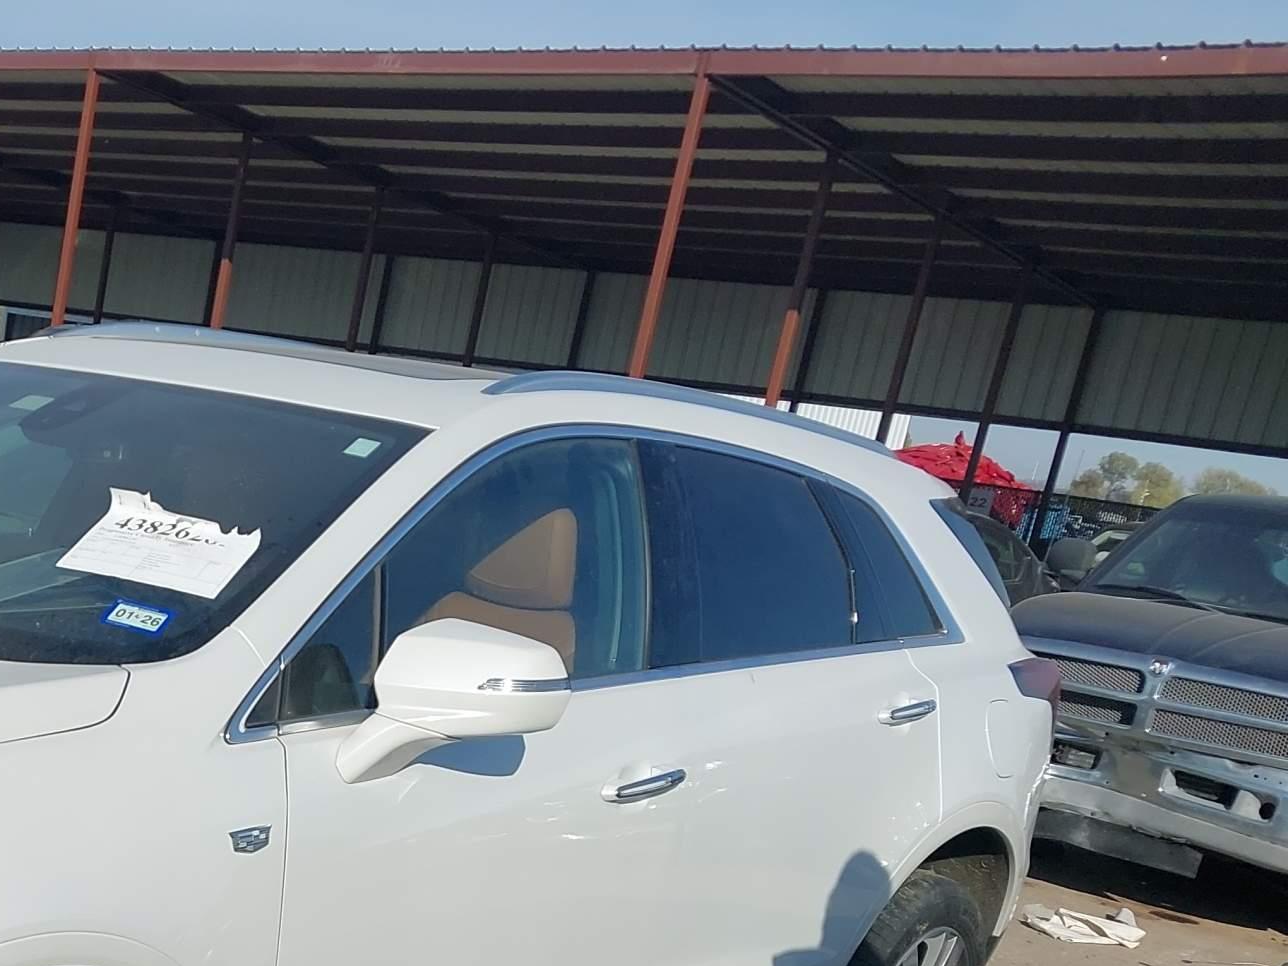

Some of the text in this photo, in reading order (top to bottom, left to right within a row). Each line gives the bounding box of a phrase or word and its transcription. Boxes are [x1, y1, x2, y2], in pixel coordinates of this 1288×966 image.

[969, 497, 987, 508] 22
[115, 608, 135, 620] 01
[140, 614, 162, 627] 26
